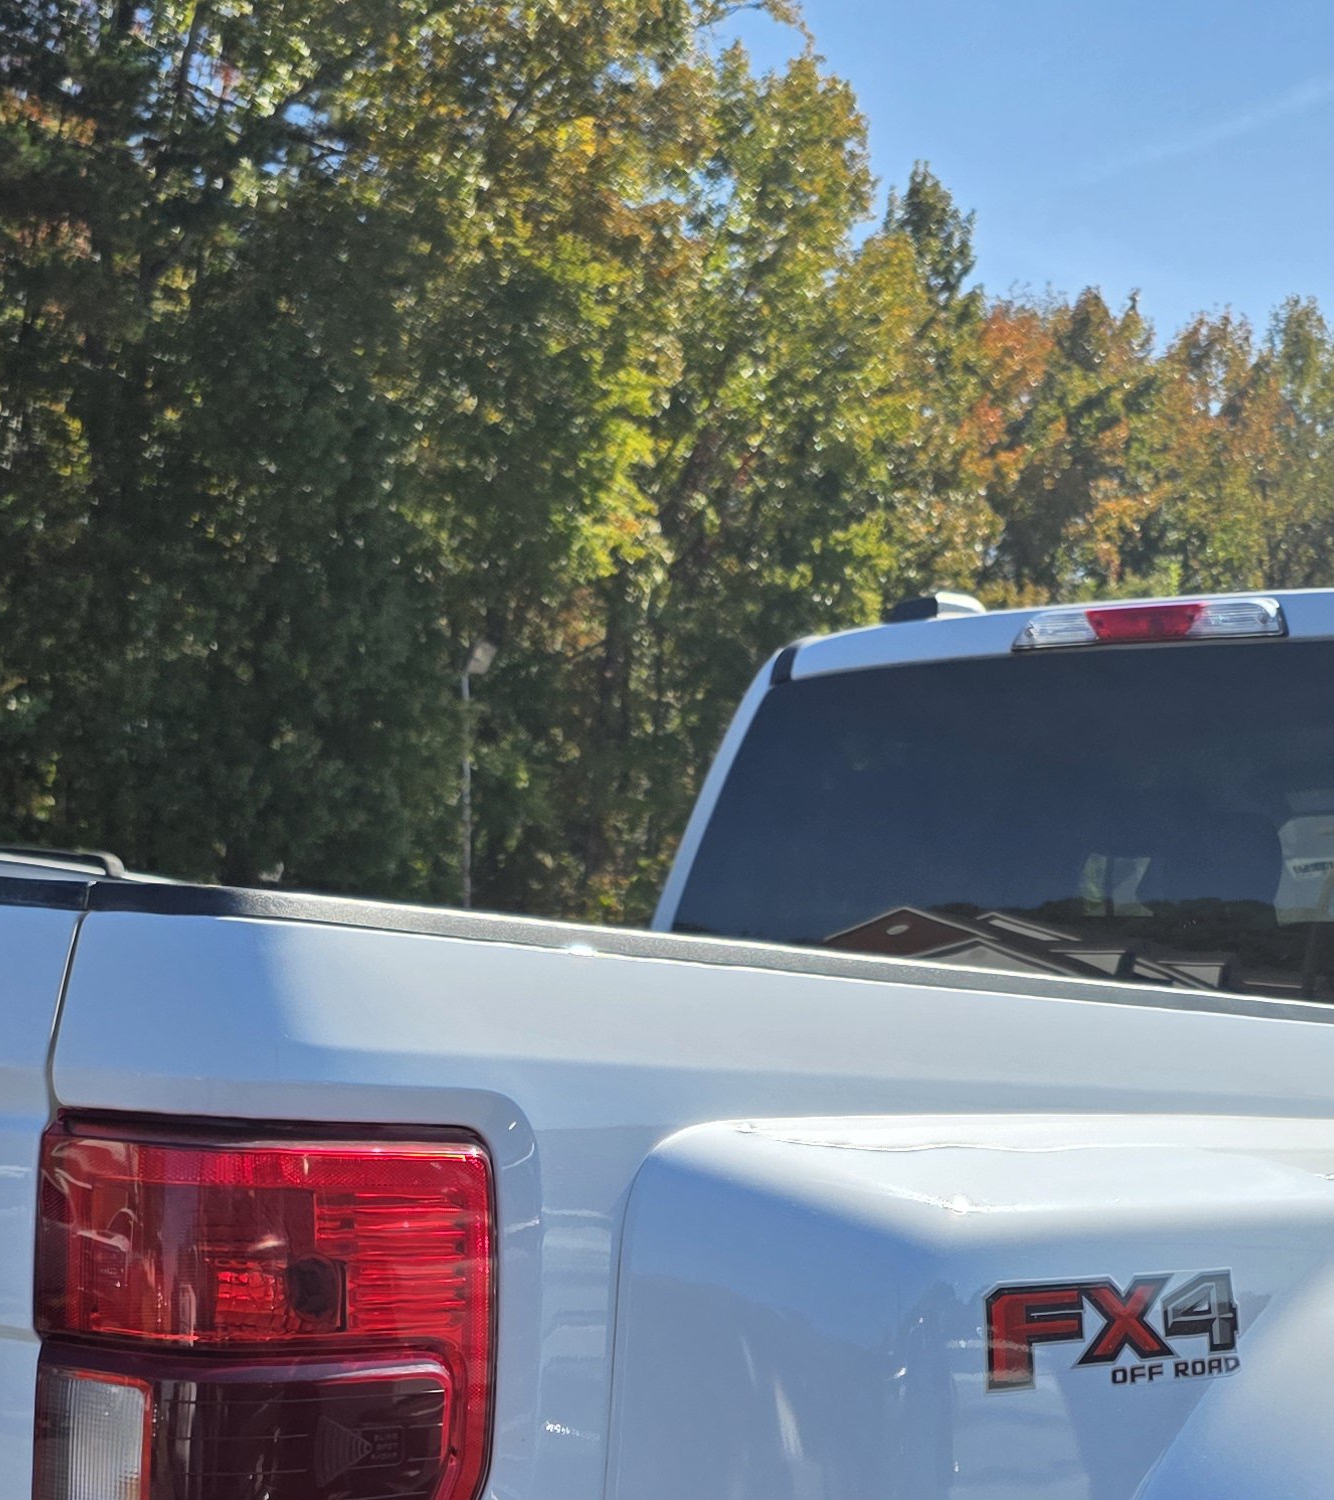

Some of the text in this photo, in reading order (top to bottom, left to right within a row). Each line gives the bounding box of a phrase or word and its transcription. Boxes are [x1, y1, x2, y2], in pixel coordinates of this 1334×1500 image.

[982, 1267, 1240, 1394] FX4
[1111, 1356, 1241, 1385] OFF ROAD
